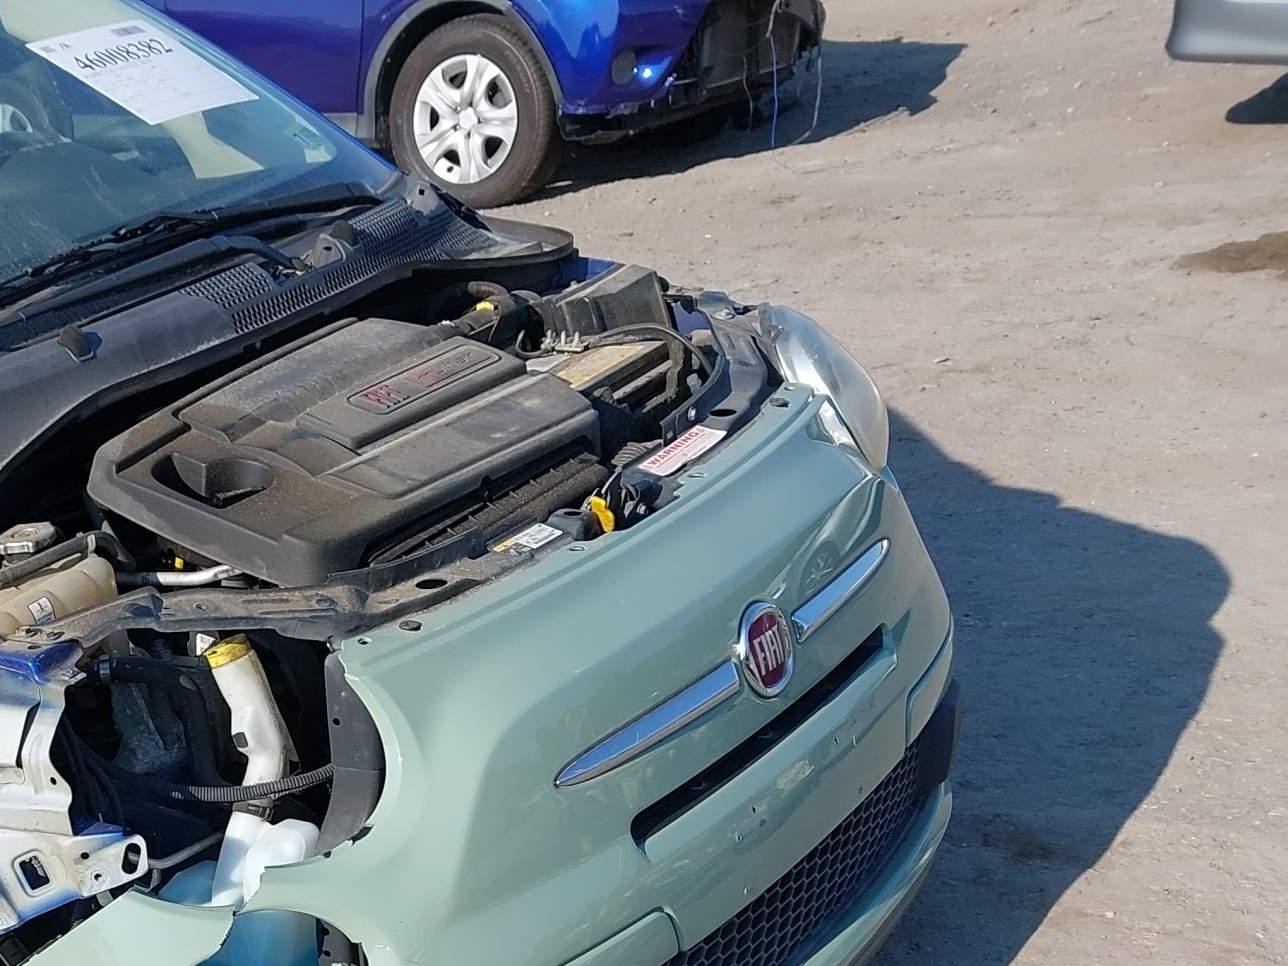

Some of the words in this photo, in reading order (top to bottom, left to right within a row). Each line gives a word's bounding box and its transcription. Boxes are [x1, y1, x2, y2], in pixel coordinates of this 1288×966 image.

[73, 38, 173, 71] 46008382
[647, 431, 701, 466] WARNING
[753, 624, 784, 676] FIAT
